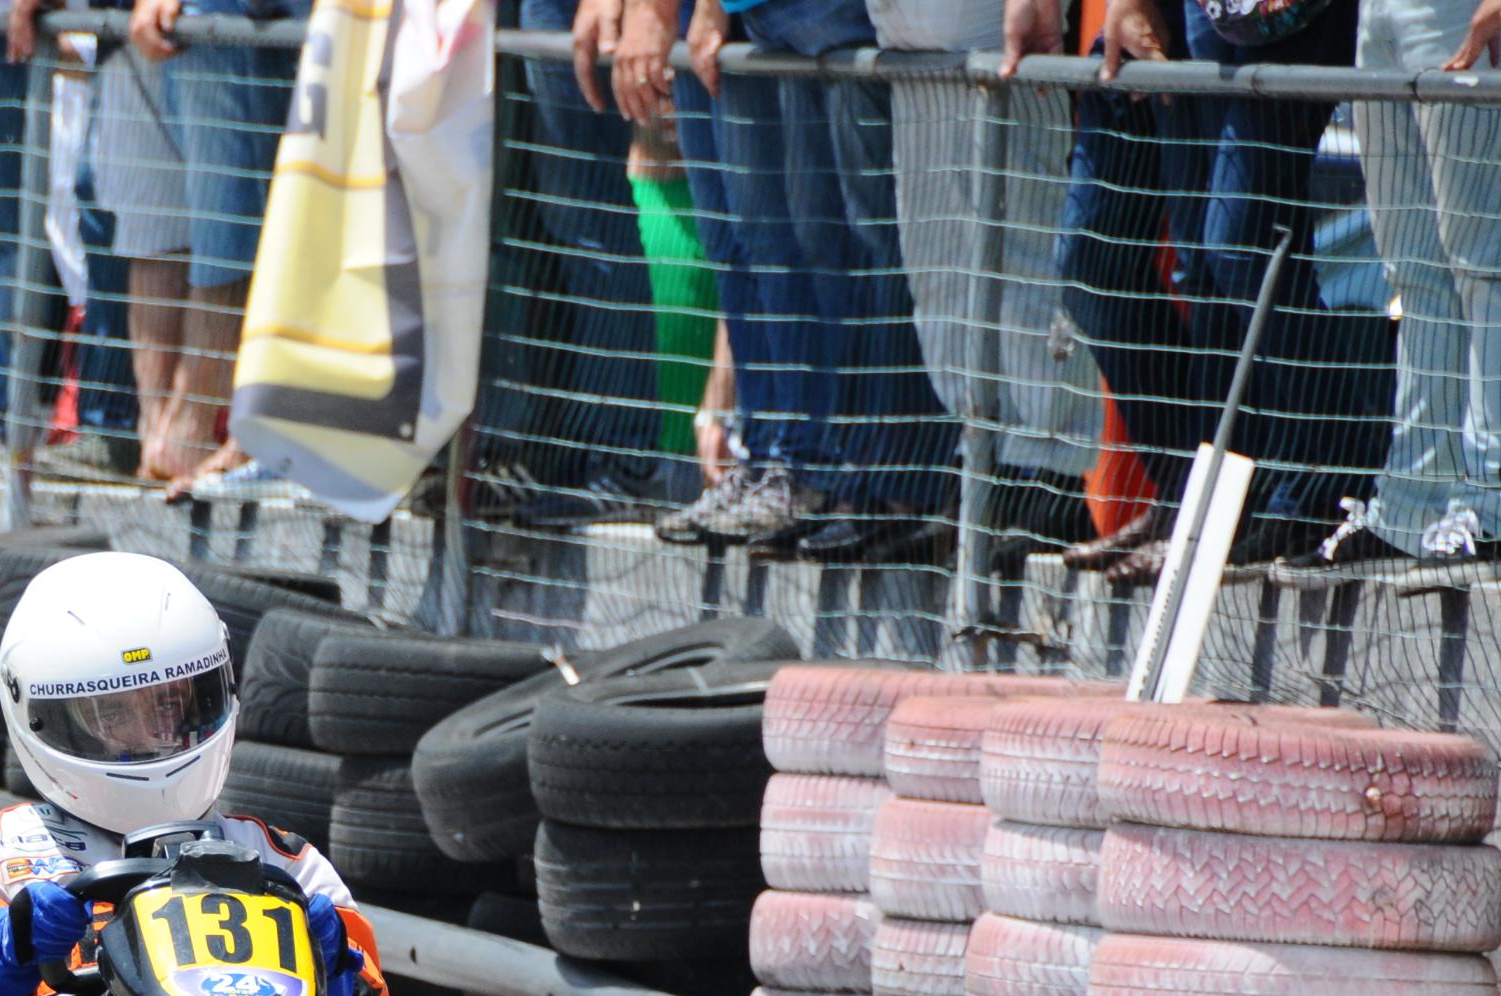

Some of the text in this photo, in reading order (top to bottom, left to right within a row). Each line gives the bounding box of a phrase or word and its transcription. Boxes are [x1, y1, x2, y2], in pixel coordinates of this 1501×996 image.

[29, 648, 228, 695] CHURRASQUEIRA RAMADINHA
[123, 649, 150, 663] OMP
[152, 893, 297, 974] 131
